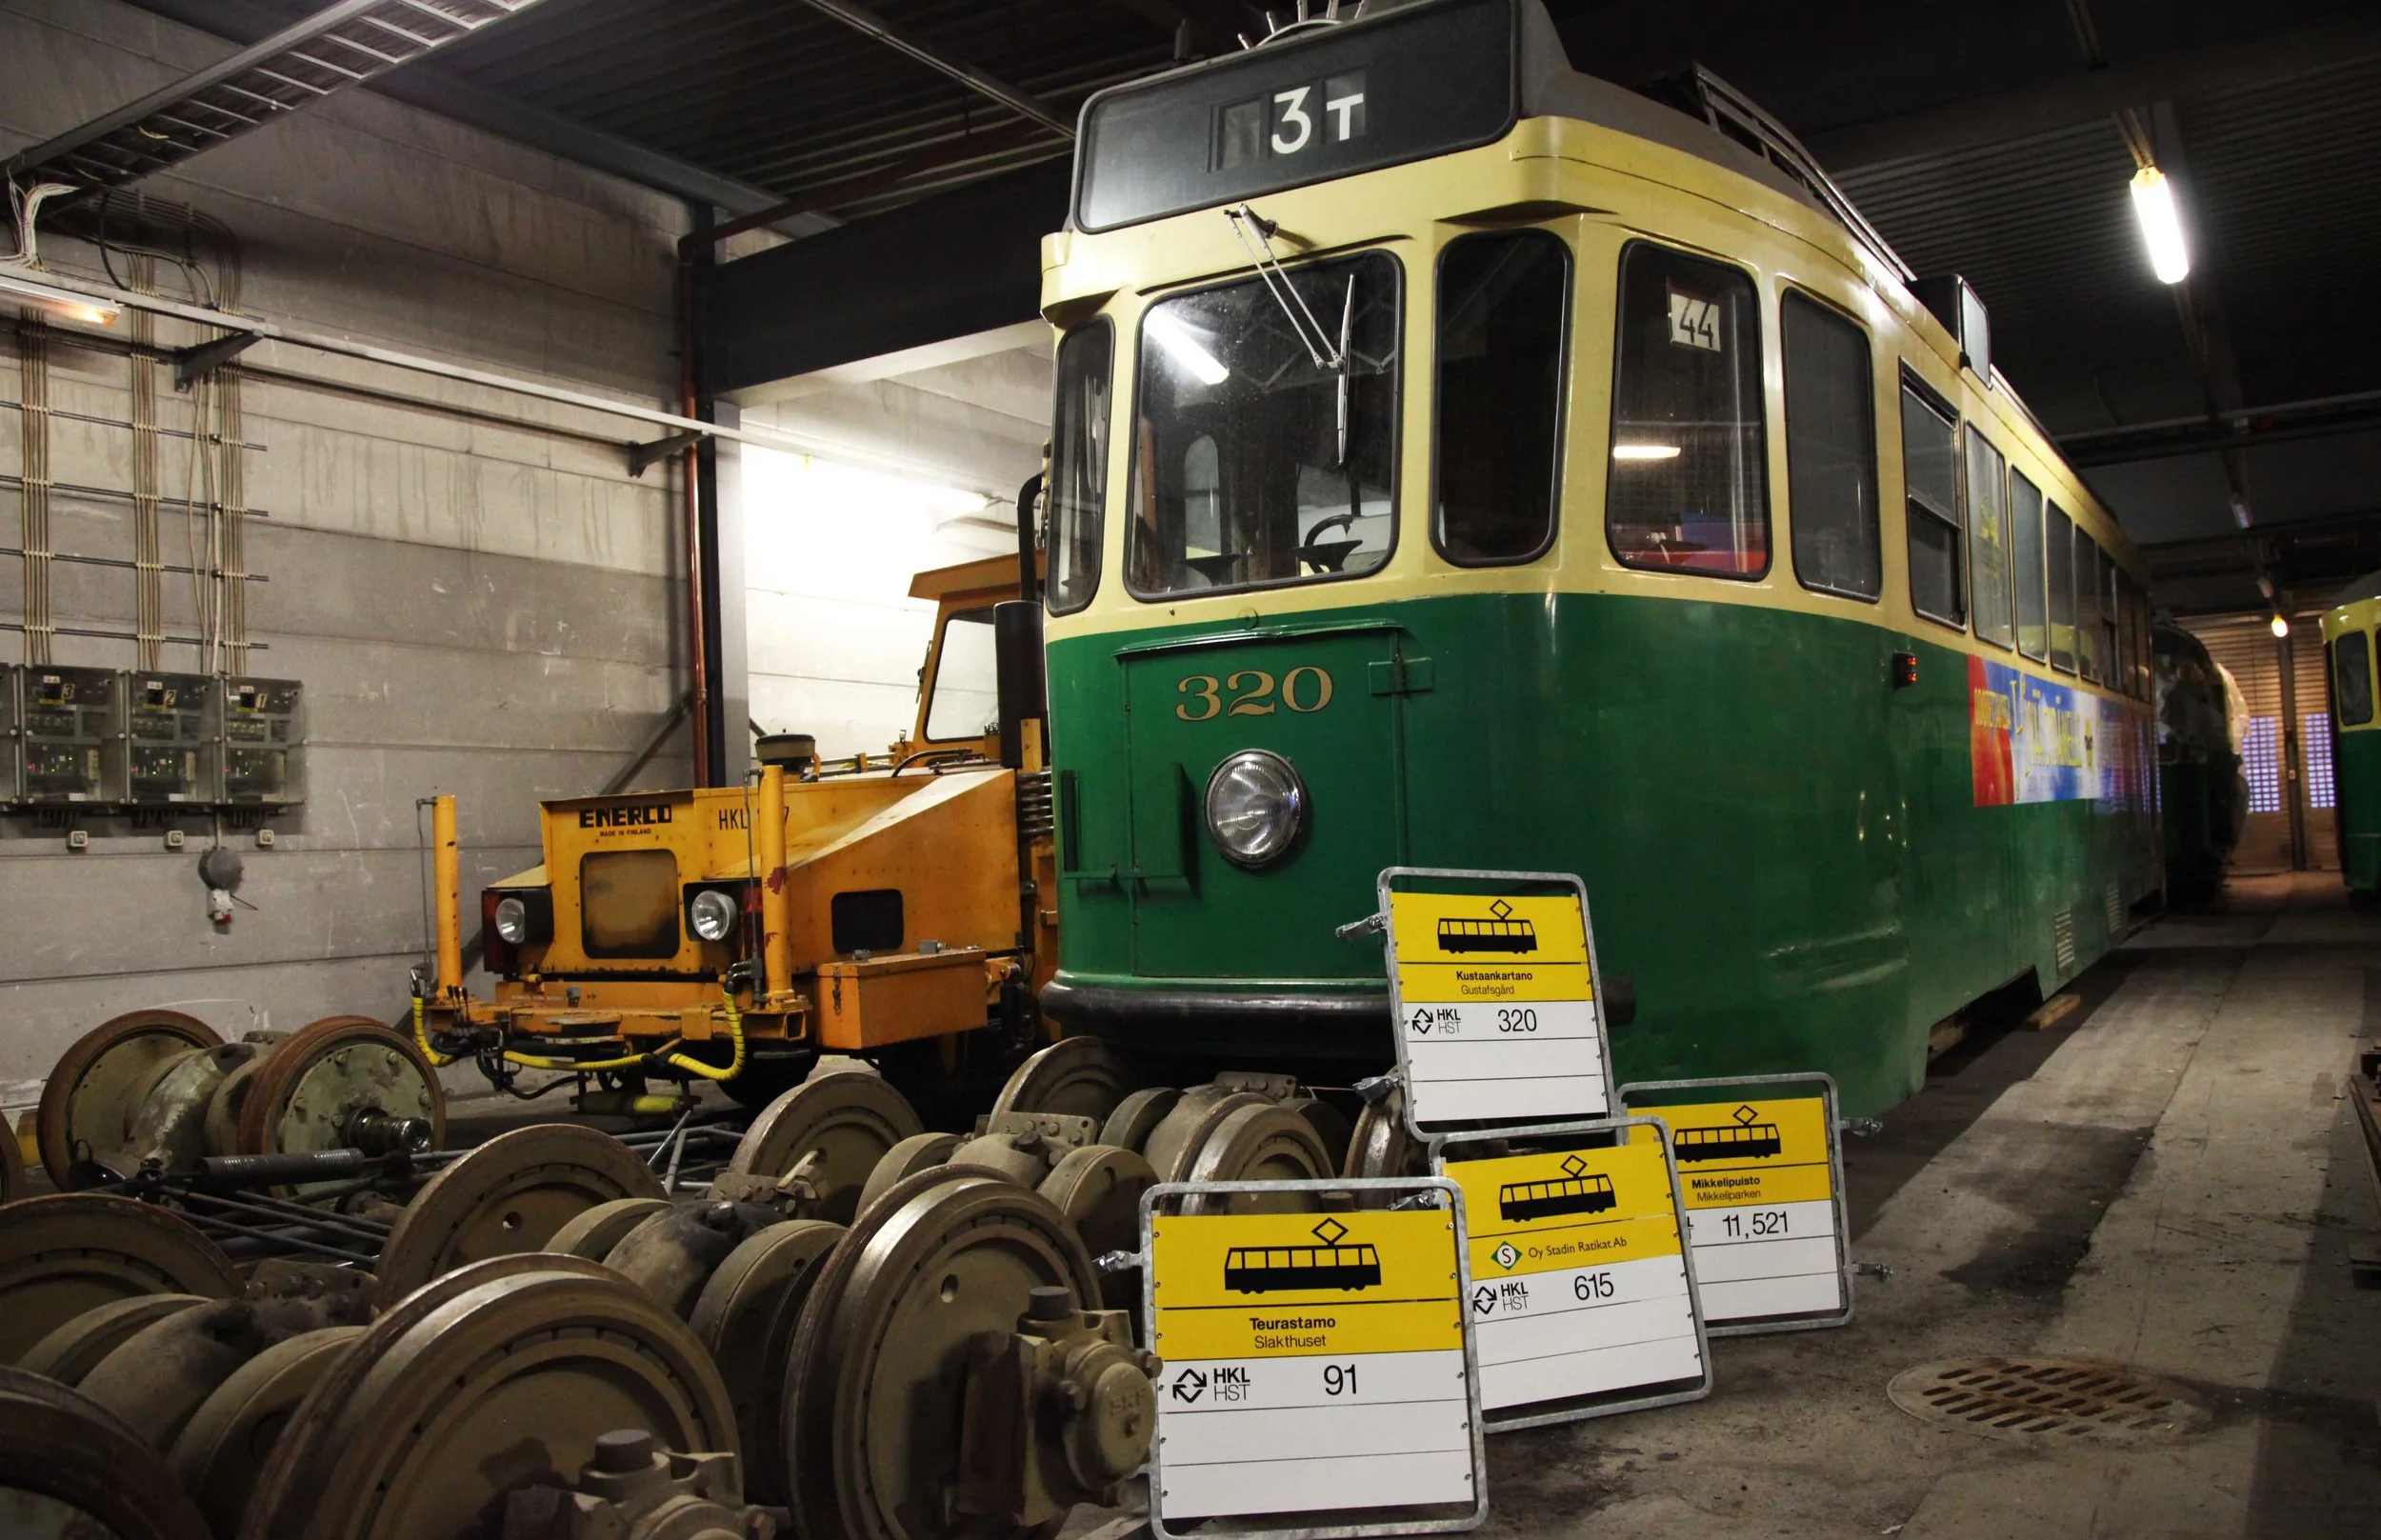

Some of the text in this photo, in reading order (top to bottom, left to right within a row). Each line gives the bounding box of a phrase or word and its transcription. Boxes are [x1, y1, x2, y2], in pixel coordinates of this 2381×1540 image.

[1679, 298, 1713, 349] 44
[1175, 666, 1333, 722] 320
[579, 804, 672, 829] ENERCO
[718, 808, 748, 830] HKL
[1455, 970, 1533, 981] Kustaankartano
[1461, 984, 1515, 997] Gustafsgård
[1436, 1009, 1462, 1021] HKL
[1497, 1009, 1537, 1032] 320
[1437, 1021, 1462, 1034] HST
[1691, 1176, 1761, 1190] Mikkelipuisto
[1696, 1190, 1761, 1202] Mikkeliparken
[1722, 1210, 1789, 1239] 11,521
[1528, 1236, 1628, 1260] Oy Stadin Ratikat Ab
[1500, 1281, 1529, 1297] HKL
[1573, 1272, 1614, 1301] 615
[1502, 1295, 1530, 1311] HST
[1250, 1317, 1336, 1330] Teurastamo
[1254, 1334, 1327, 1350] Slakthuset
[1213, 1367, 1251, 1384] HKL
[1323, 1364, 1357, 1396] 91
[1213, 1384, 1251, 1401] HST
